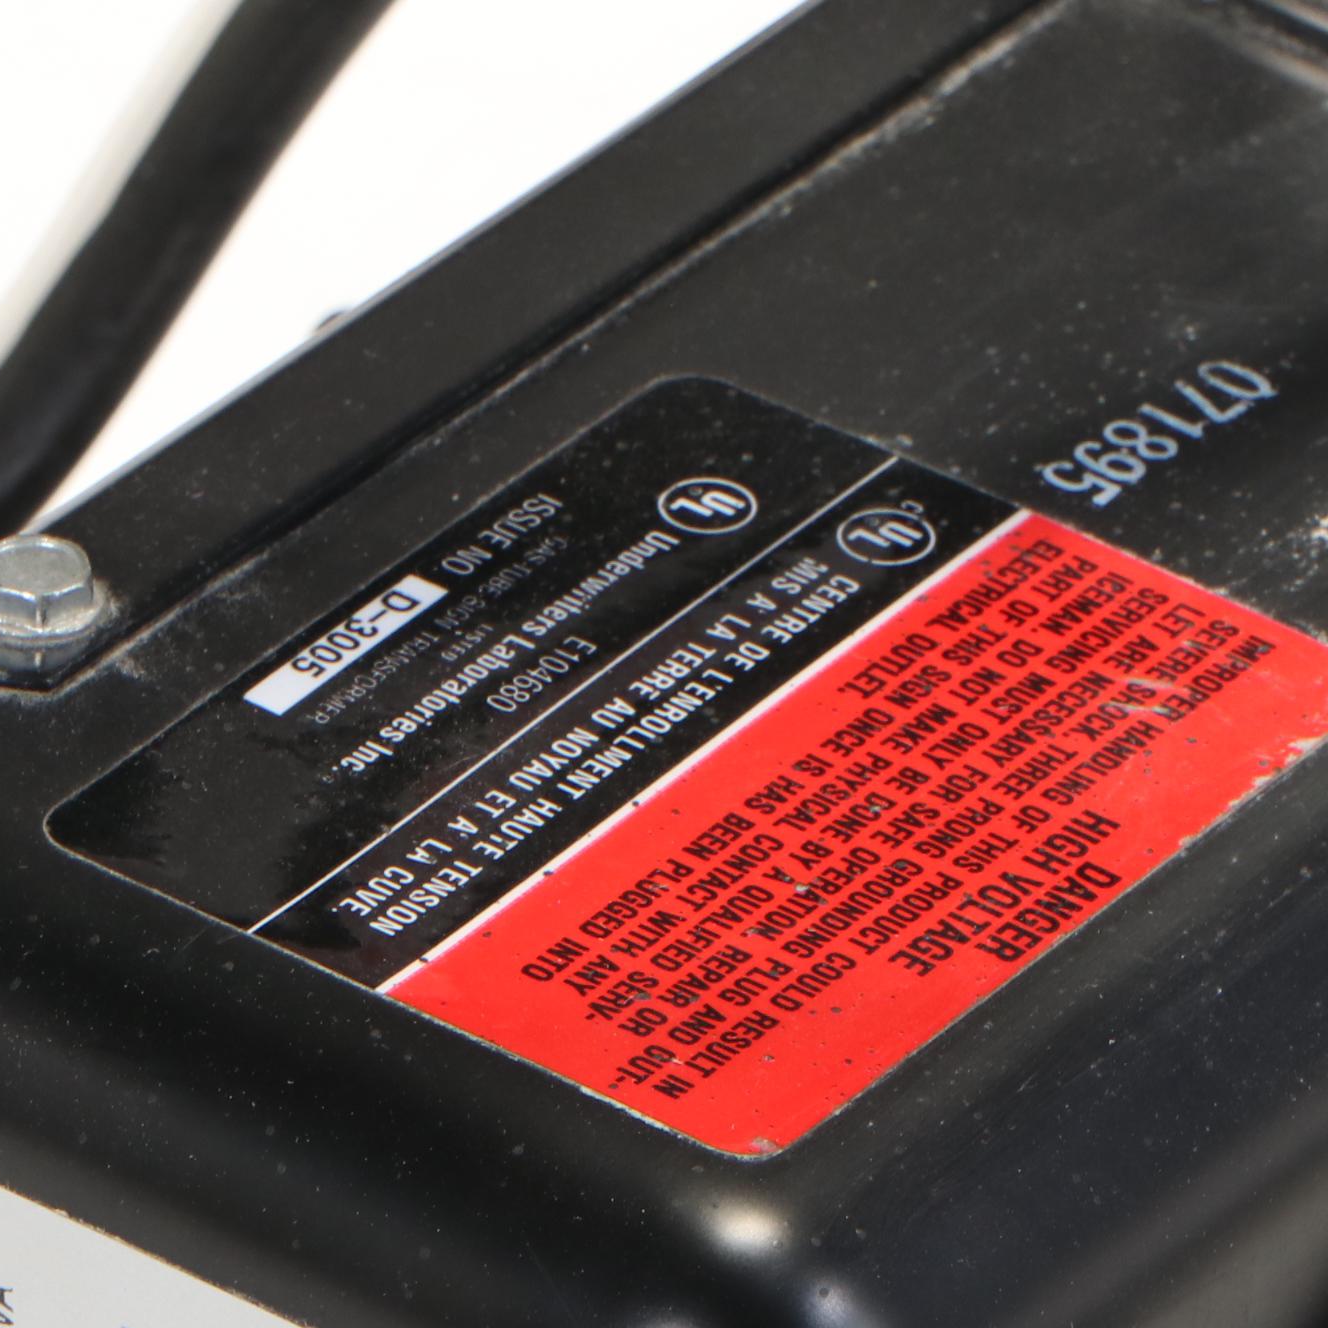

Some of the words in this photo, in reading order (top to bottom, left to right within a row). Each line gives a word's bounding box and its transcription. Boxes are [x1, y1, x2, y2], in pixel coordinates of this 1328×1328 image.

[1034, 360, 1278, 508] 071895
[478, 494, 562, 548] ISSUE
[522, 531, 679, 636] Underwriters
[771, 558, 828, 594] MIS
[927, 539, 1064, 631] ELECTRICAL
[1033, 557, 1098, 601] PART
[706, 614, 751, 640] LA
[761, 575, 859, 643] CENTRE
[1001, 600, 1039, 626] OF
[1040, 573, 1130, 635] ICEMAN.
[1153, 603, 1205, 638] LET
[291, 590, 420, 678] D-3005
[724, 642, 770, 670] DE
[942, 624, 1007, 665] THIS
[997, 639, 1043, 667] DO
[1045, 589, 1168, 673] SERVICING
[1104, 635, 1158, 673] ARE
[1146, 620, 1239, 684] SEVERE
[306, 632, 439, 724] TRANSFORMER
[380, 635, 535, 742] Laboratories
[487, 637, 596, 712] E104680
[629, 643, 716, 699] TERRE
[838, 633, 940, 698] OUTLET.
[885, 665, 951, 708] SIGN
[950, 668, 1006, 705] NOT
[1154, 636, 1275, 722] IMPROPER
[592, 697, 635, 728] AU
[982, 672, 1055, 724] MUST
[983, 672, 1114, 767] NECESSARY
[1064, 681, 1157, 741] SHOCK.
[557, 669, 733, 799] L'ENROLLMENT
[821, 708, 895, 756] ONCE
[883, 704, 956, 753] MAKE
[923, 723, 989, 769] ONLY
[509, 728, 599, 790] NOYAU
[792, 754, 833, 776] IS
[885, 767, 929, 794] BE
[930, 765, 990, 803] FOR
[992, 745, 1077, 799] THREE
[1042, 721, 1163, 805] HANDLING
[475, 790, 516, 818] ET
[745, 776, 804, 814] HAS
[773, 752, 893, 830] PHYSICAL
[473, 798, 562, 859] HAUTE
[683, 813, 755, 860] BEEN
[821, 792, 896, 842] DONE
[871, 803, 940, 848] SAFE
[914, 797, 1005, 858] PRONG
[1012, 805, 1052, 833] OF
[1023, 810, 1120, 874] HIGH
[406, 839, 452, 864] LA
[677, 834, 784, 911] CONTACT
[763, 867, 795, 884] A
[789, 841, 833, 870] BY
[953, 833, 1019, 873] THIS
[332, 867, 414, 916] CUVE.
[370, 861, 482, 935] TENSION
[579, 859, 694, 938] PLUGGED
[742, 847, 880, 940] OPERATION.
[783, 859, 923, 958] GROUNDING
[849, 872, 963, 954] PRODUCT
[976, 862, 1121, 962] DANGER
[611, 911, 686, 957] WITH
[651, 885, 774, 971] QUALIFIED
[889, 872, 1044, 976] VOLTAGE
[522, 938, 589, 981] INTO
[564, 955, 620, 996] ANY
[658, 945, 752, 1007] REPAIR
[718, 958, 793, 1006] PLUG
[770, 953, 856, 1011] COULD
[586, 971, 659, 1020] SERV-
[619, 1008, 668, 1036] OR
[668, 1004, 726, 1045] AND
[685, 1011, 779, 1078] RESULT
[616, 1045, 676, 1084] OUT-
[653, 1074, 694, 1099] IN
